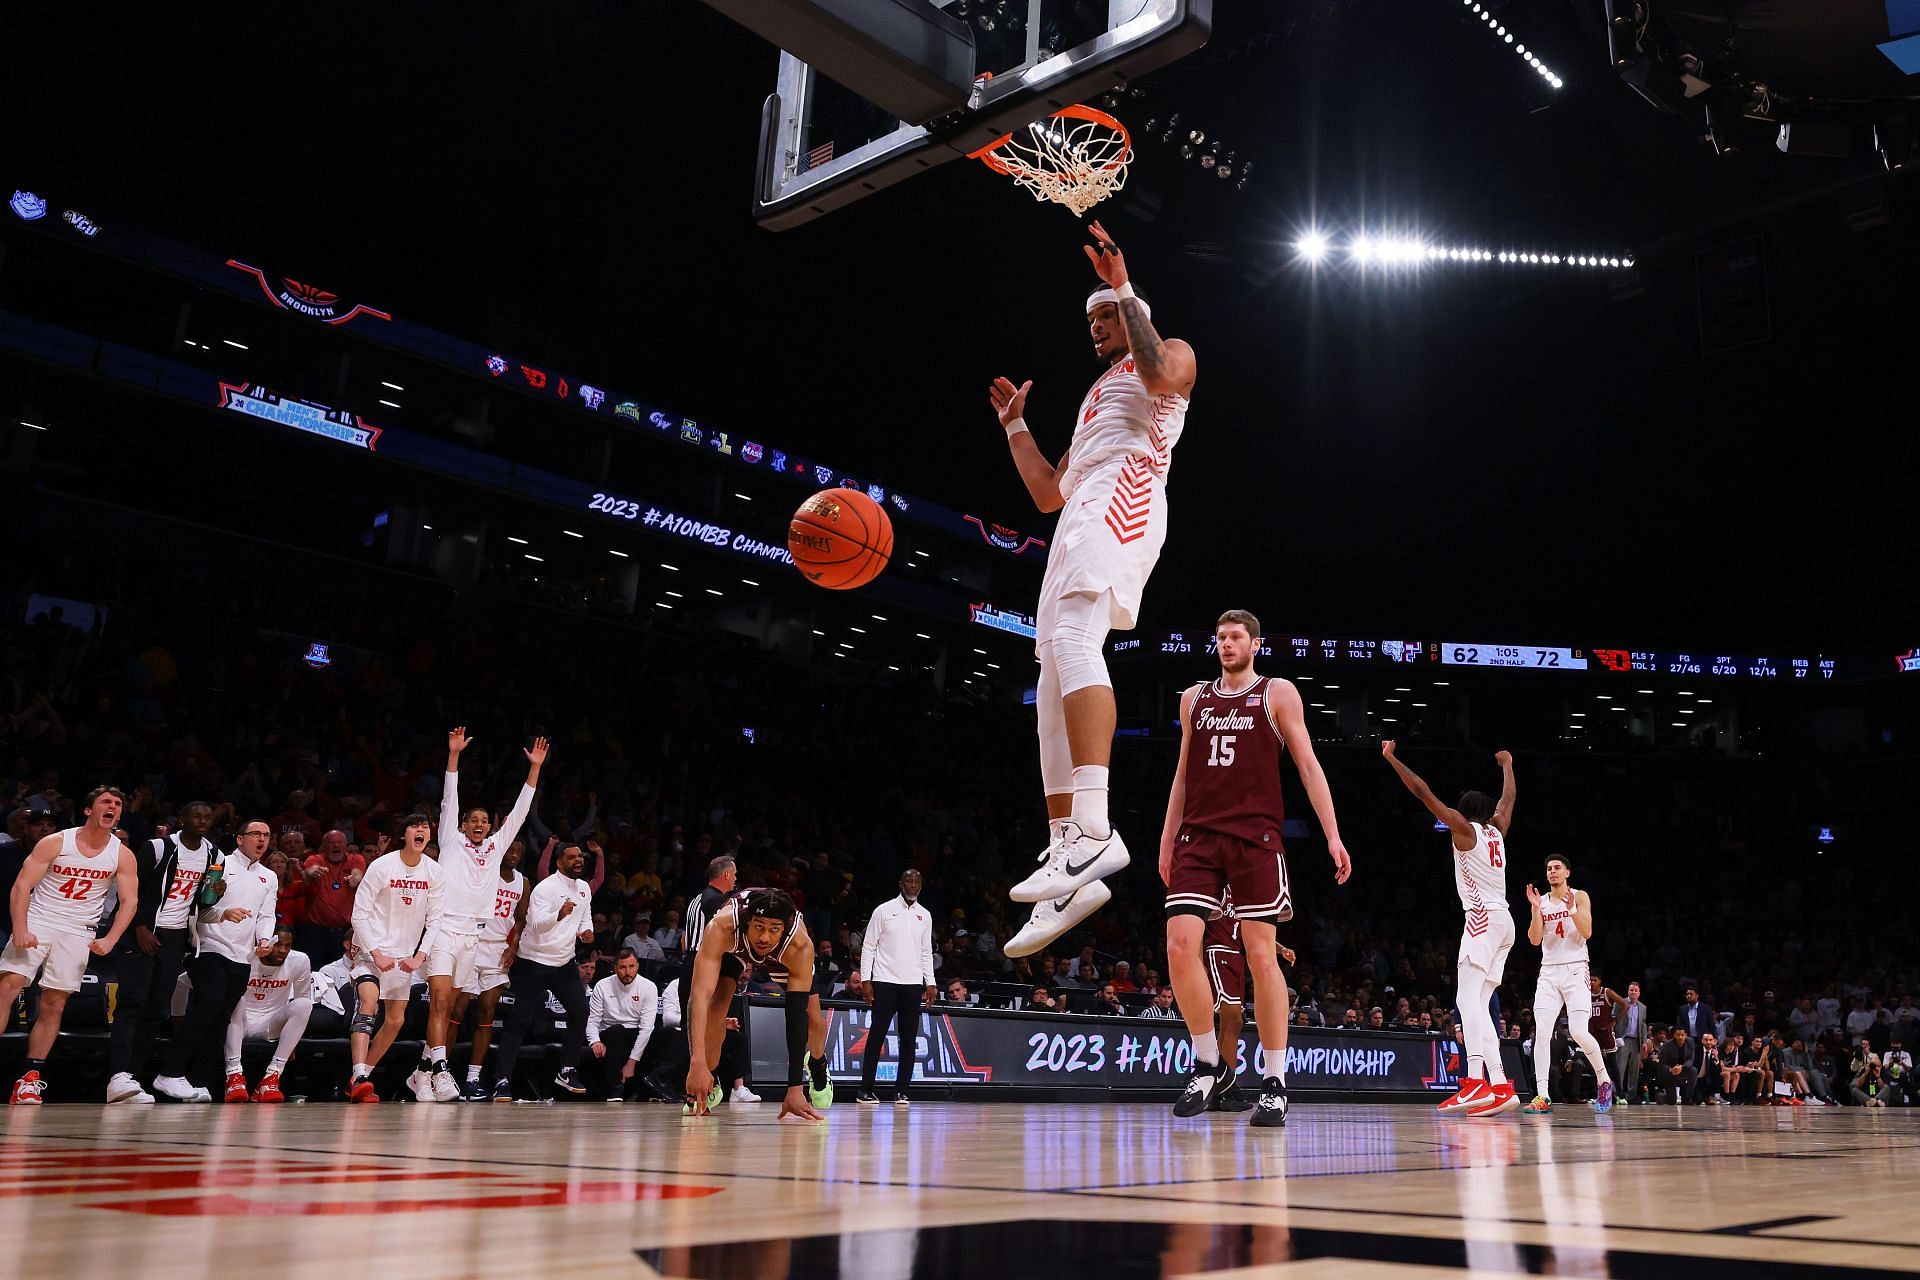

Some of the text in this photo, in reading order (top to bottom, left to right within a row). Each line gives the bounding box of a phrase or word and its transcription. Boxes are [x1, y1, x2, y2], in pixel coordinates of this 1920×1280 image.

[280, 292, 335, 316] BROOKLYN
[245, 401, 355, 442] CHAMPIONSHIP
[588, 493, 799, 566] 2023 #A10MBB CHAMPIO
[990, 533, 1018, 549] BROOKLYN
[1170, 633, 1183, 641] FG
[1114, 639, 1140, 651] 5:27 PM
[1161, 643, 1192, 653] 23/51
[1349, 640, 1376, 648] FLS 10
[1430, 643, 1438, 652] B
[1295, 648, 1307, 657] 21
[1323, 649, 1336, 658] 12
[1348, 650, 1365, 658] TOL
[1453, 647, 1479, 663] 62
[1495, 647, 1519, 657] 1:05
[1575, 649, 1583, 658] B
[1631, 652, 1655, 661] FLS 7
[1535, 650, 1560, 667] 72
[1679, 655, 1690, 663] FG
[1716, 656, 1732, 664] 3PT
[1792, 659, 1809, 667] REB
[1631, 662, 1656, 671] TOL 2
[1669, 664, 1700, 674] 27/46
[1819, 660, 1835, 668] AST
[1712, 665, 1738, 676] 6/20
[1749, 667, 1777, 677] 12/14
[1795, 668, 1807, 678] 27
[1822, 669, 1833, 678] 17
[1196, 707, 1254, 731] Fordham
[1207, 735, 1237, 767] 15
[1488, 840, 1503, 868] 15
[53, 865, 112, 880] DAYTON
[59, 878, 93, 900] 42
[167, 879, 194, 901] 24
[494, 898, 512, 918] 23
[1542, 910, 1569, 921] DAYTO
[1555, 920, 1565, 939] 4
[248, 978, 289, 989] AYTON
[1025, 1032, 1107, 1073] 2023
[1254, 1045, 1396, 1077] CAMPIONSHIP
